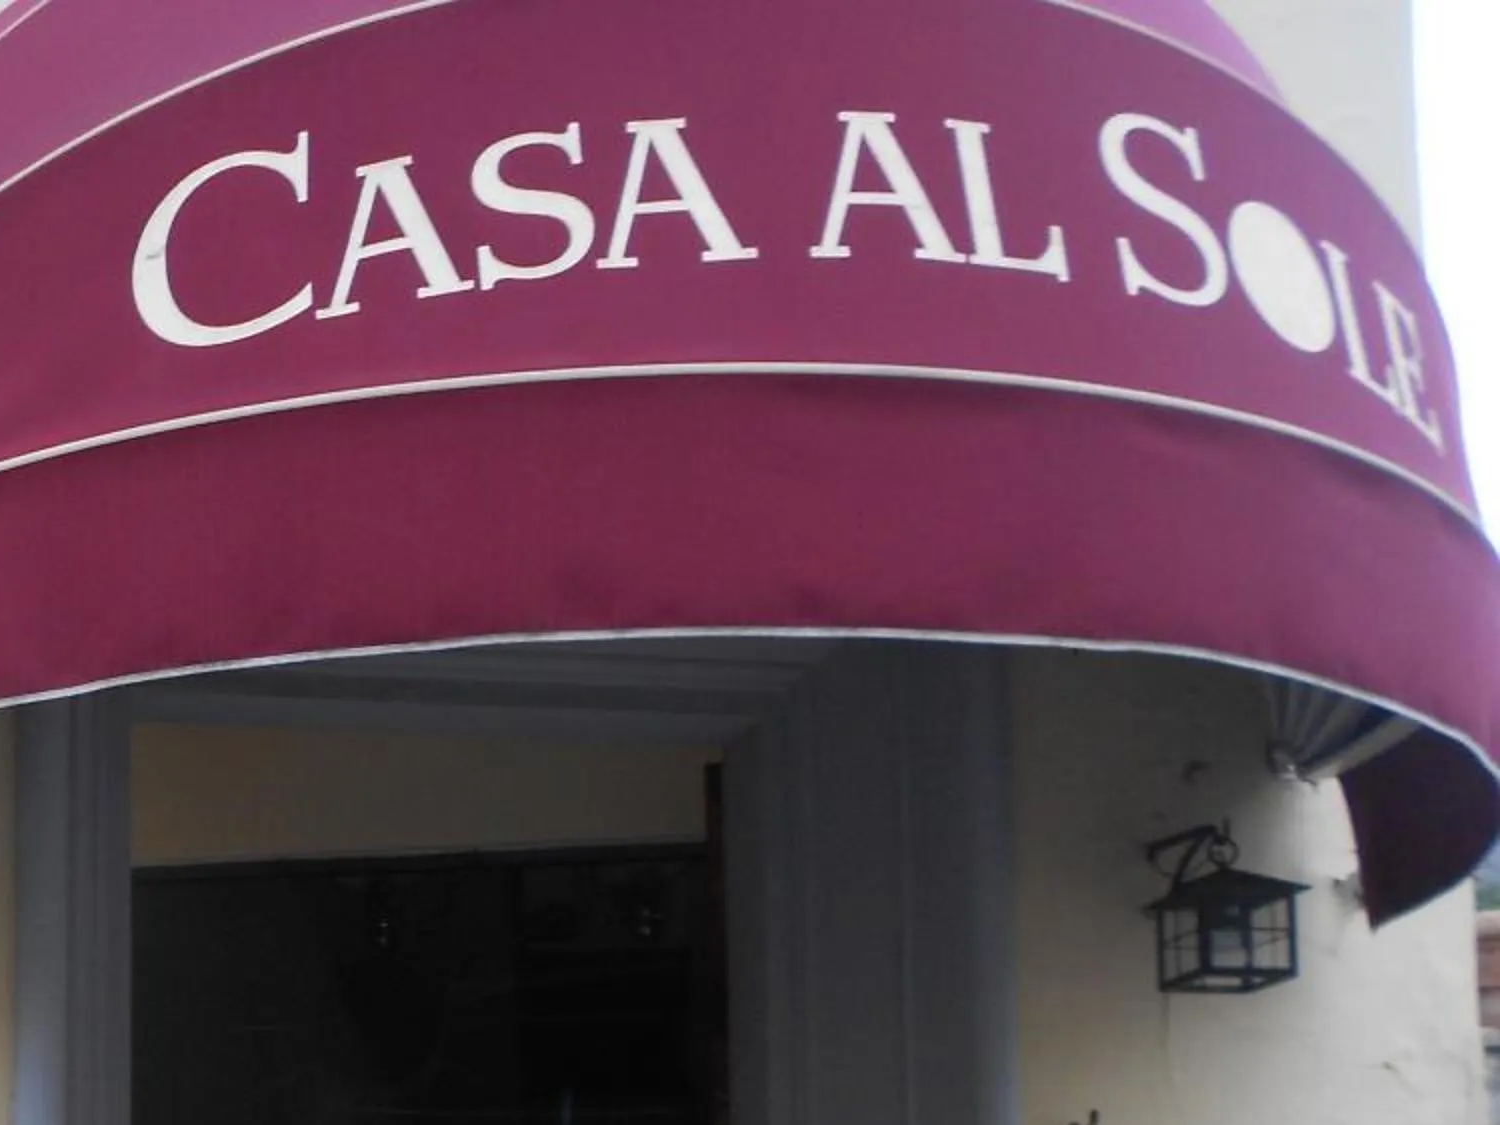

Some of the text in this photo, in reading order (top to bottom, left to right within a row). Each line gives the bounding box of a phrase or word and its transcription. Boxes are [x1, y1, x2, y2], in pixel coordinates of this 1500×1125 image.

[131, 111, 1446, 457] CASA AL SOLE
